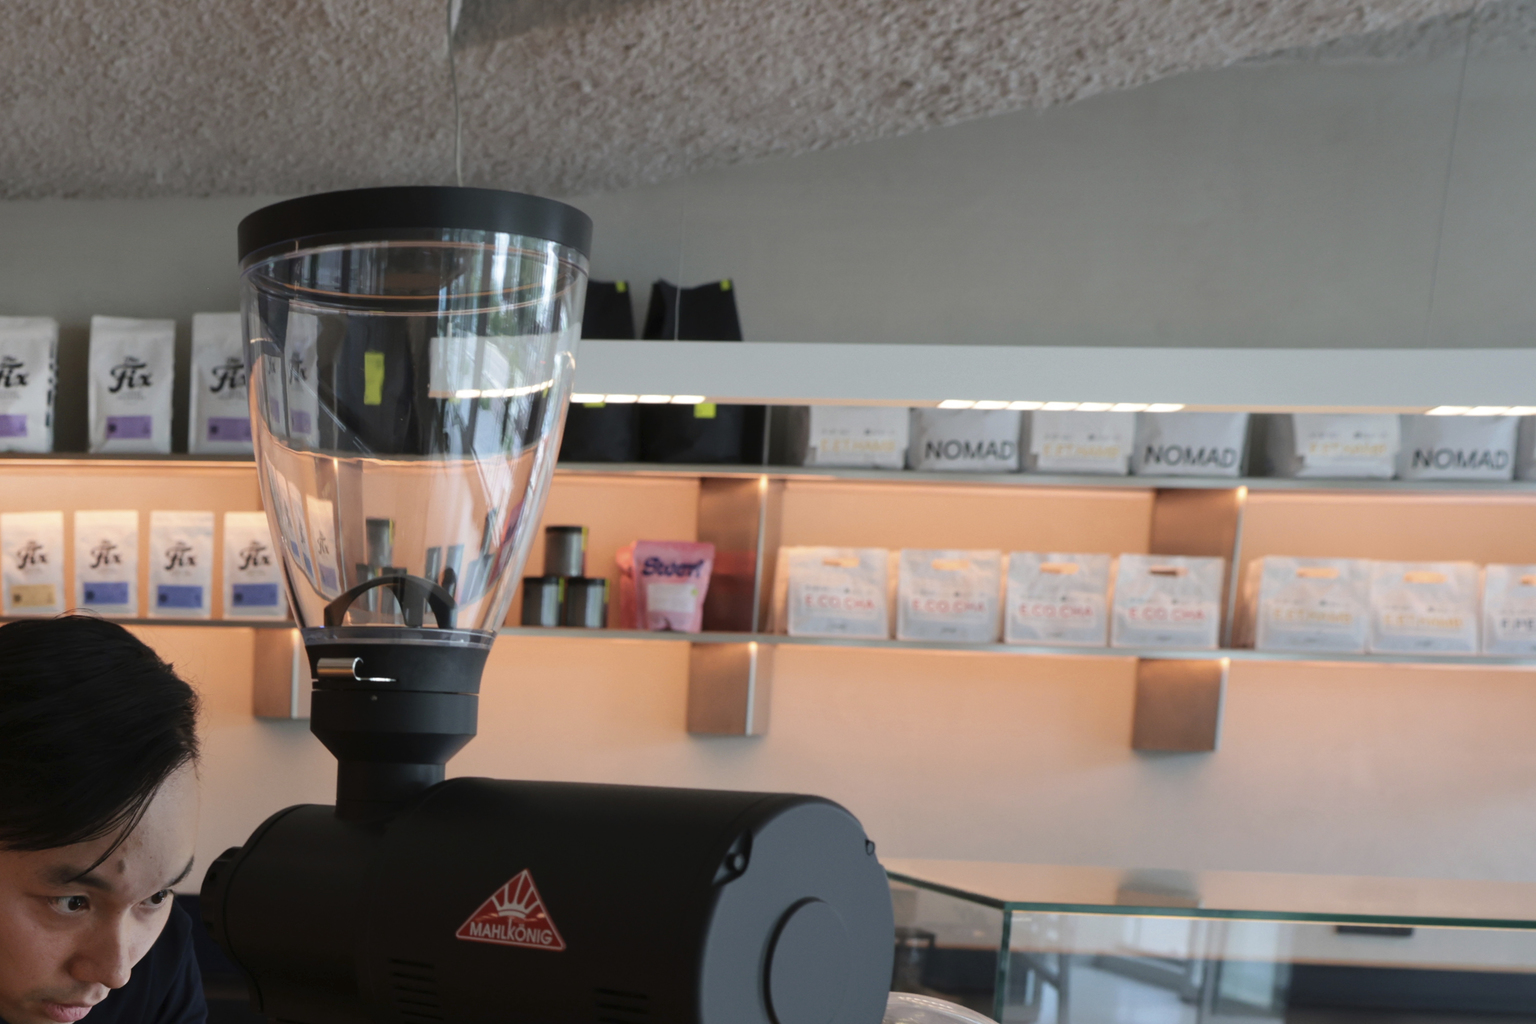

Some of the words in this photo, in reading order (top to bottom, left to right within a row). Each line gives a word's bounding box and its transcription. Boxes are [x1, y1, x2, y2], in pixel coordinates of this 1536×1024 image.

[109, 362, 152, 393] Fix
[924, 440, 1016, 462] NOMAD
[1142, 444, 1239, 469] NOMAD
[1410, 447, 1510, 470] NOMAD
[470, 918, 552, 944] MAHLKÖNIG
